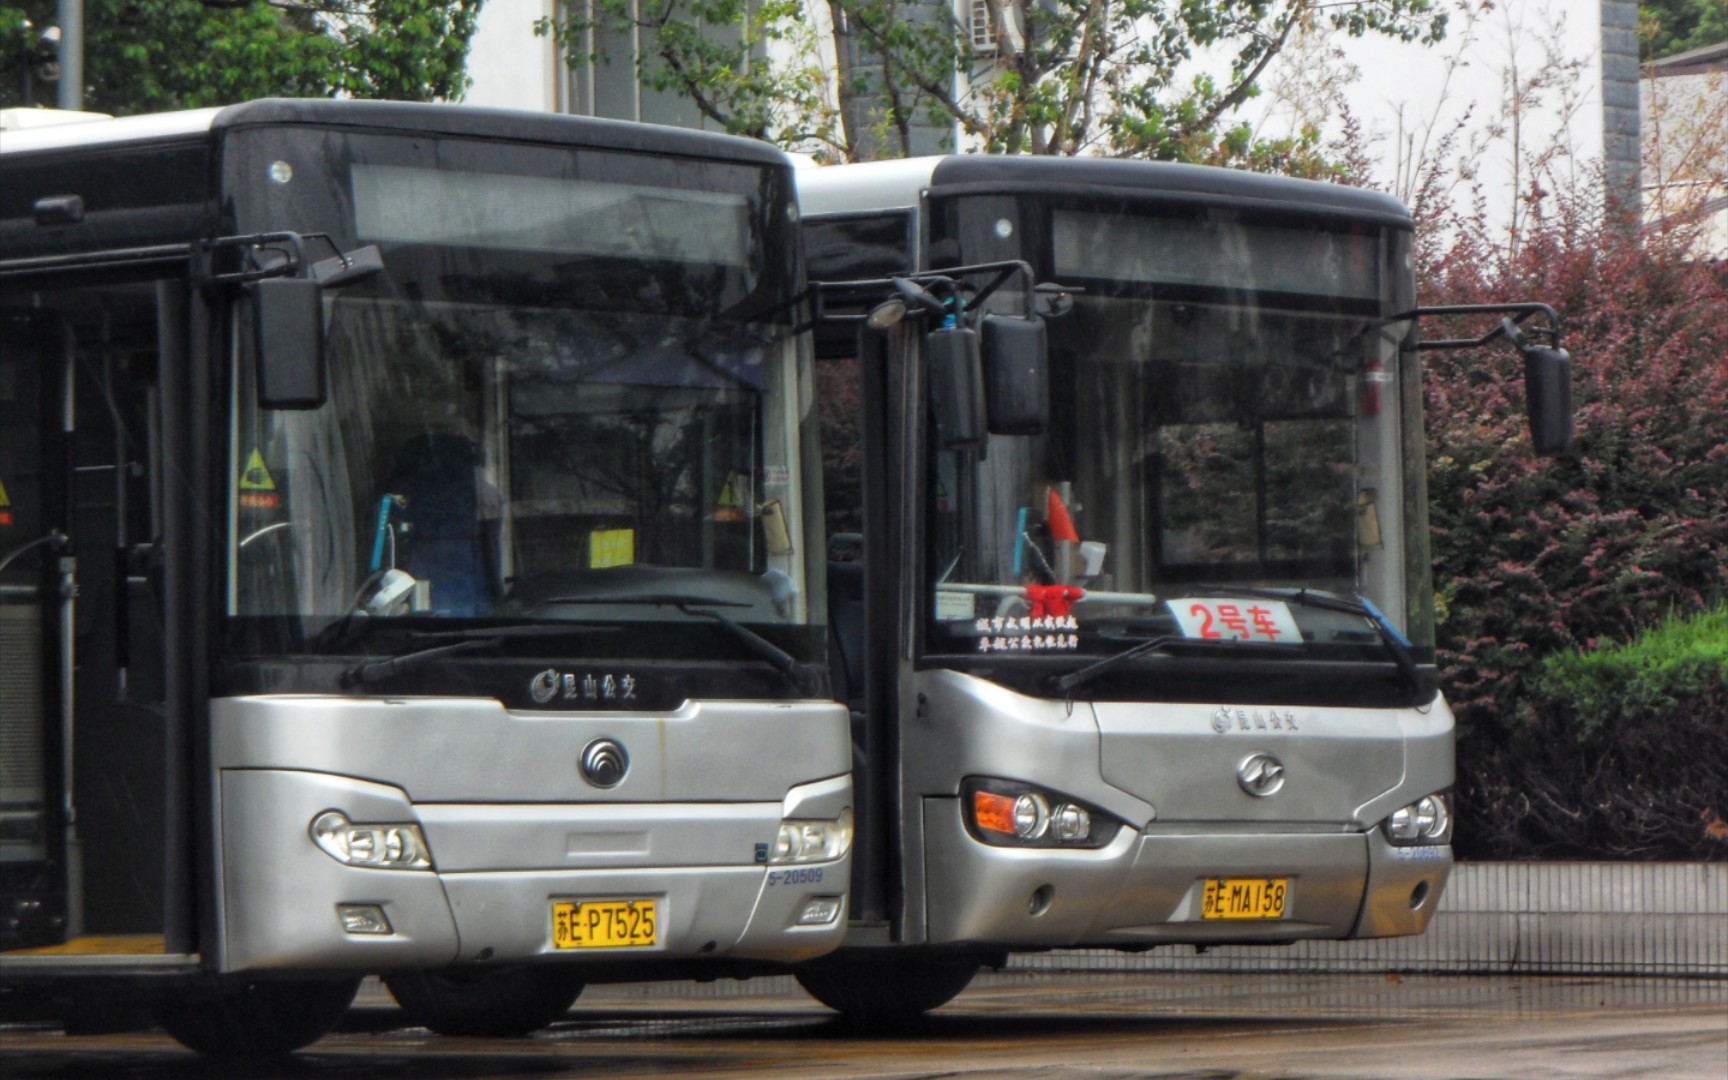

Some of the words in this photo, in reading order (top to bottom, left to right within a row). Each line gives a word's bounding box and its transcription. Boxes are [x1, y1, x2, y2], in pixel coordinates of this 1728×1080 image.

[1190, 604, 1281, 641] 2号车
[563, 674, 637, 699] 昆山公交
[1236, 710, 1299, 731] 昆山公交
[768, 868, 823, 887] 5-20509
[557, 907, 655, 942] 苏E·P7525
